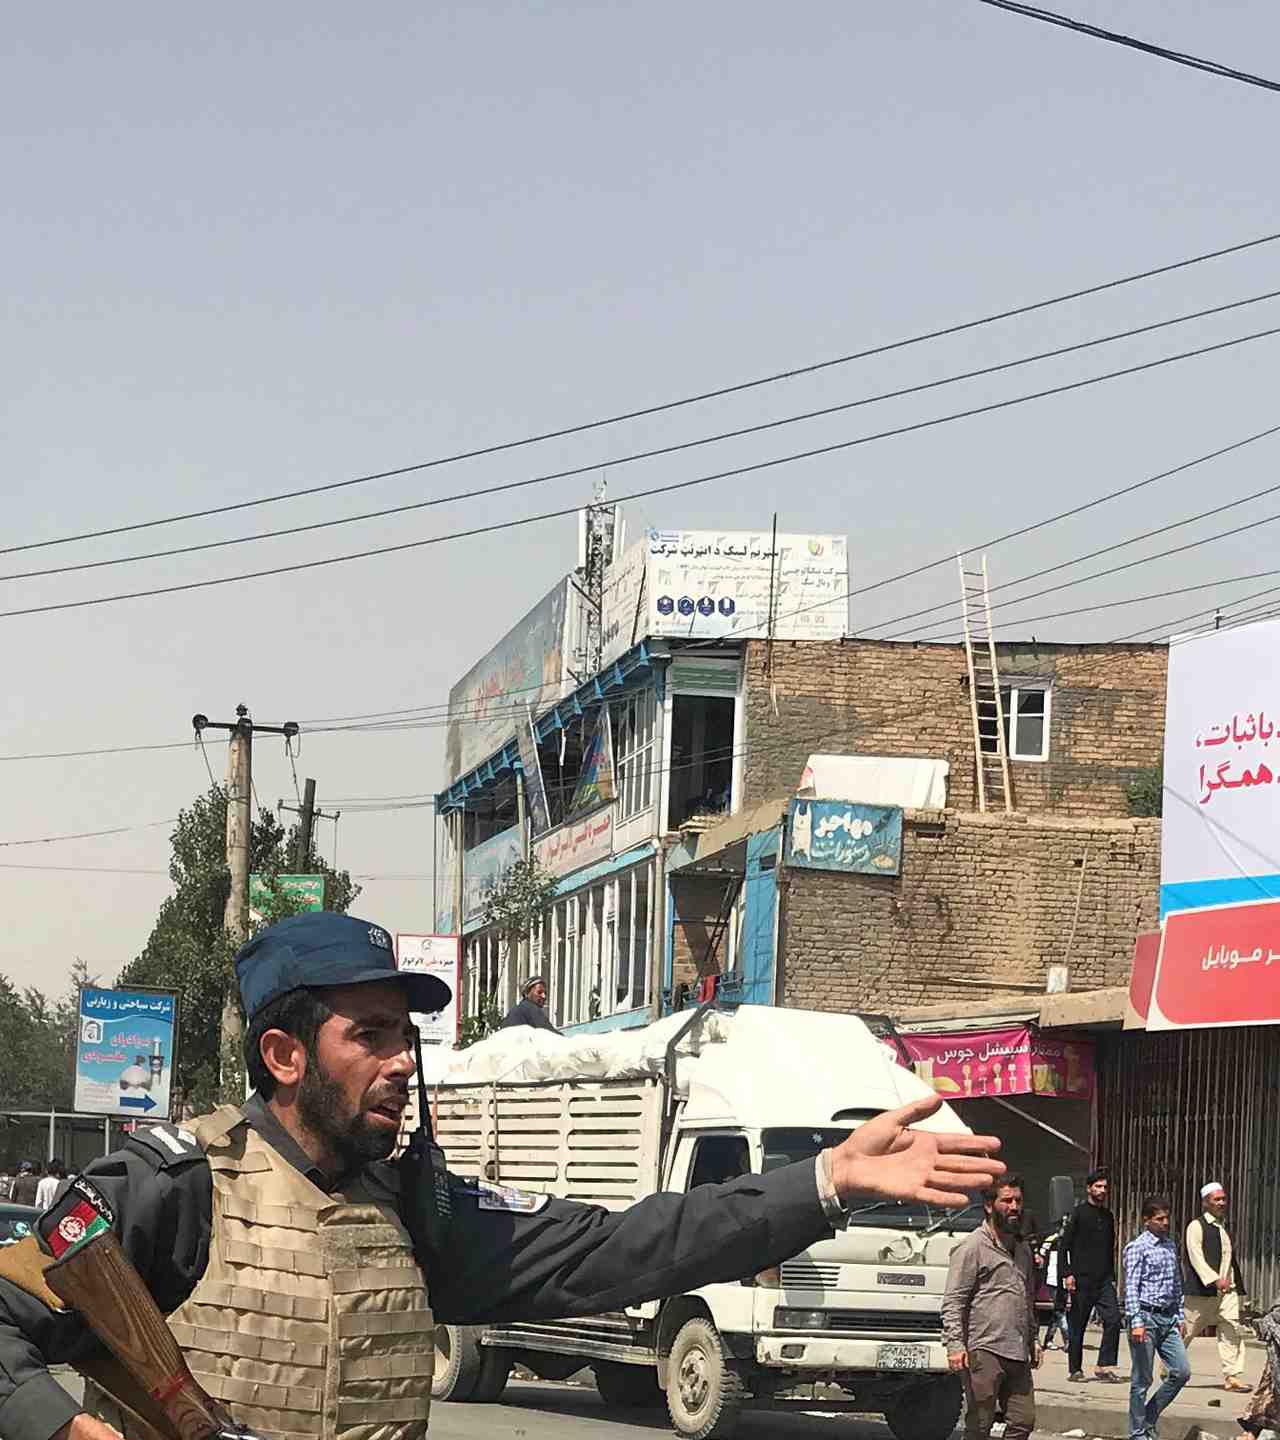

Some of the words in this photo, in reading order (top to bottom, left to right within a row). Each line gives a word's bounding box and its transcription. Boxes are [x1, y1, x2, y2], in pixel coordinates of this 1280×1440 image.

[1199, 760, 1273, 804] همگرا
[1201, 944, 1262, 970] موبایل
[150, 1000, 172, 1014] شرکت
[937, 1047, 974, 1064] جوس
